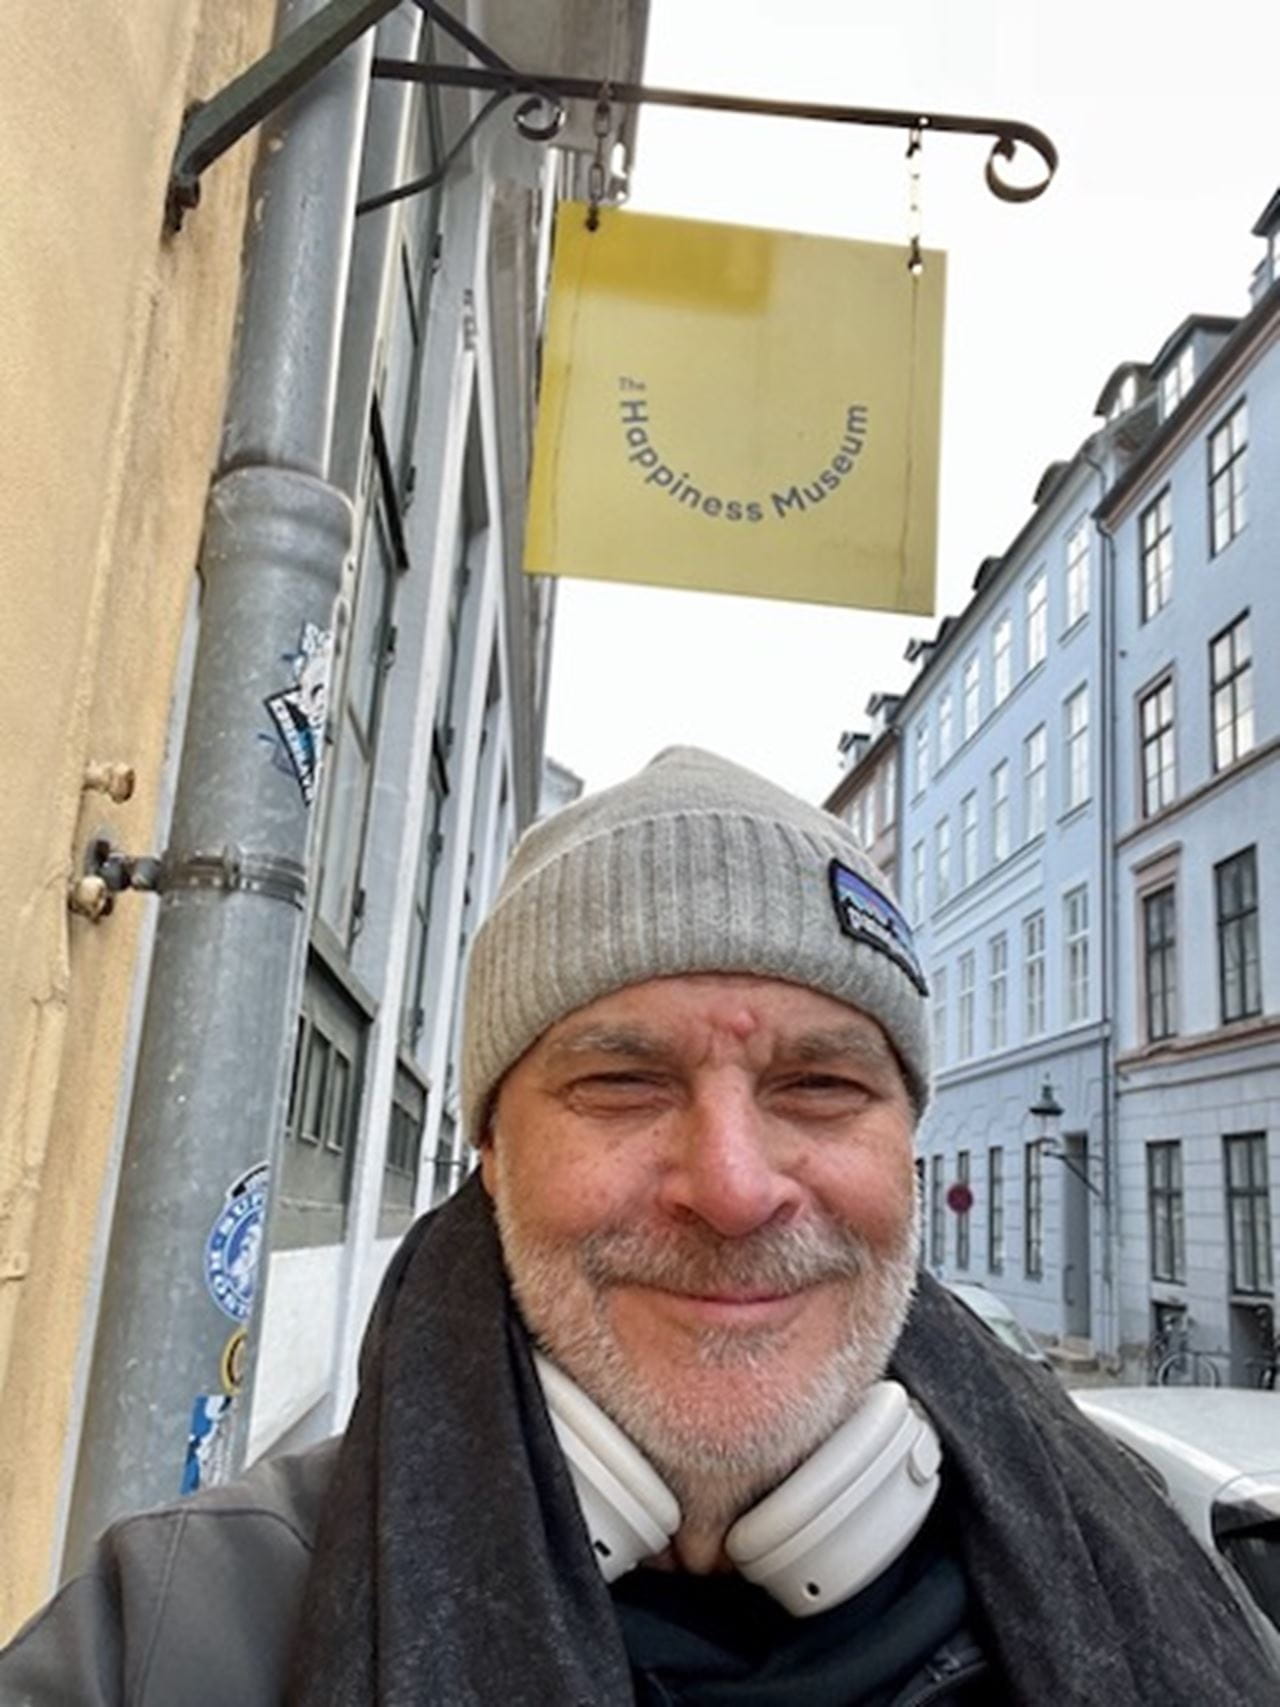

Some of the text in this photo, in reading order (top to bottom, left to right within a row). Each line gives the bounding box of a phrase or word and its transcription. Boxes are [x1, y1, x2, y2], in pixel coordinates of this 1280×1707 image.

[619, 376, 646, 392] The
[620, 400, 868, 522] Happiness Museum
